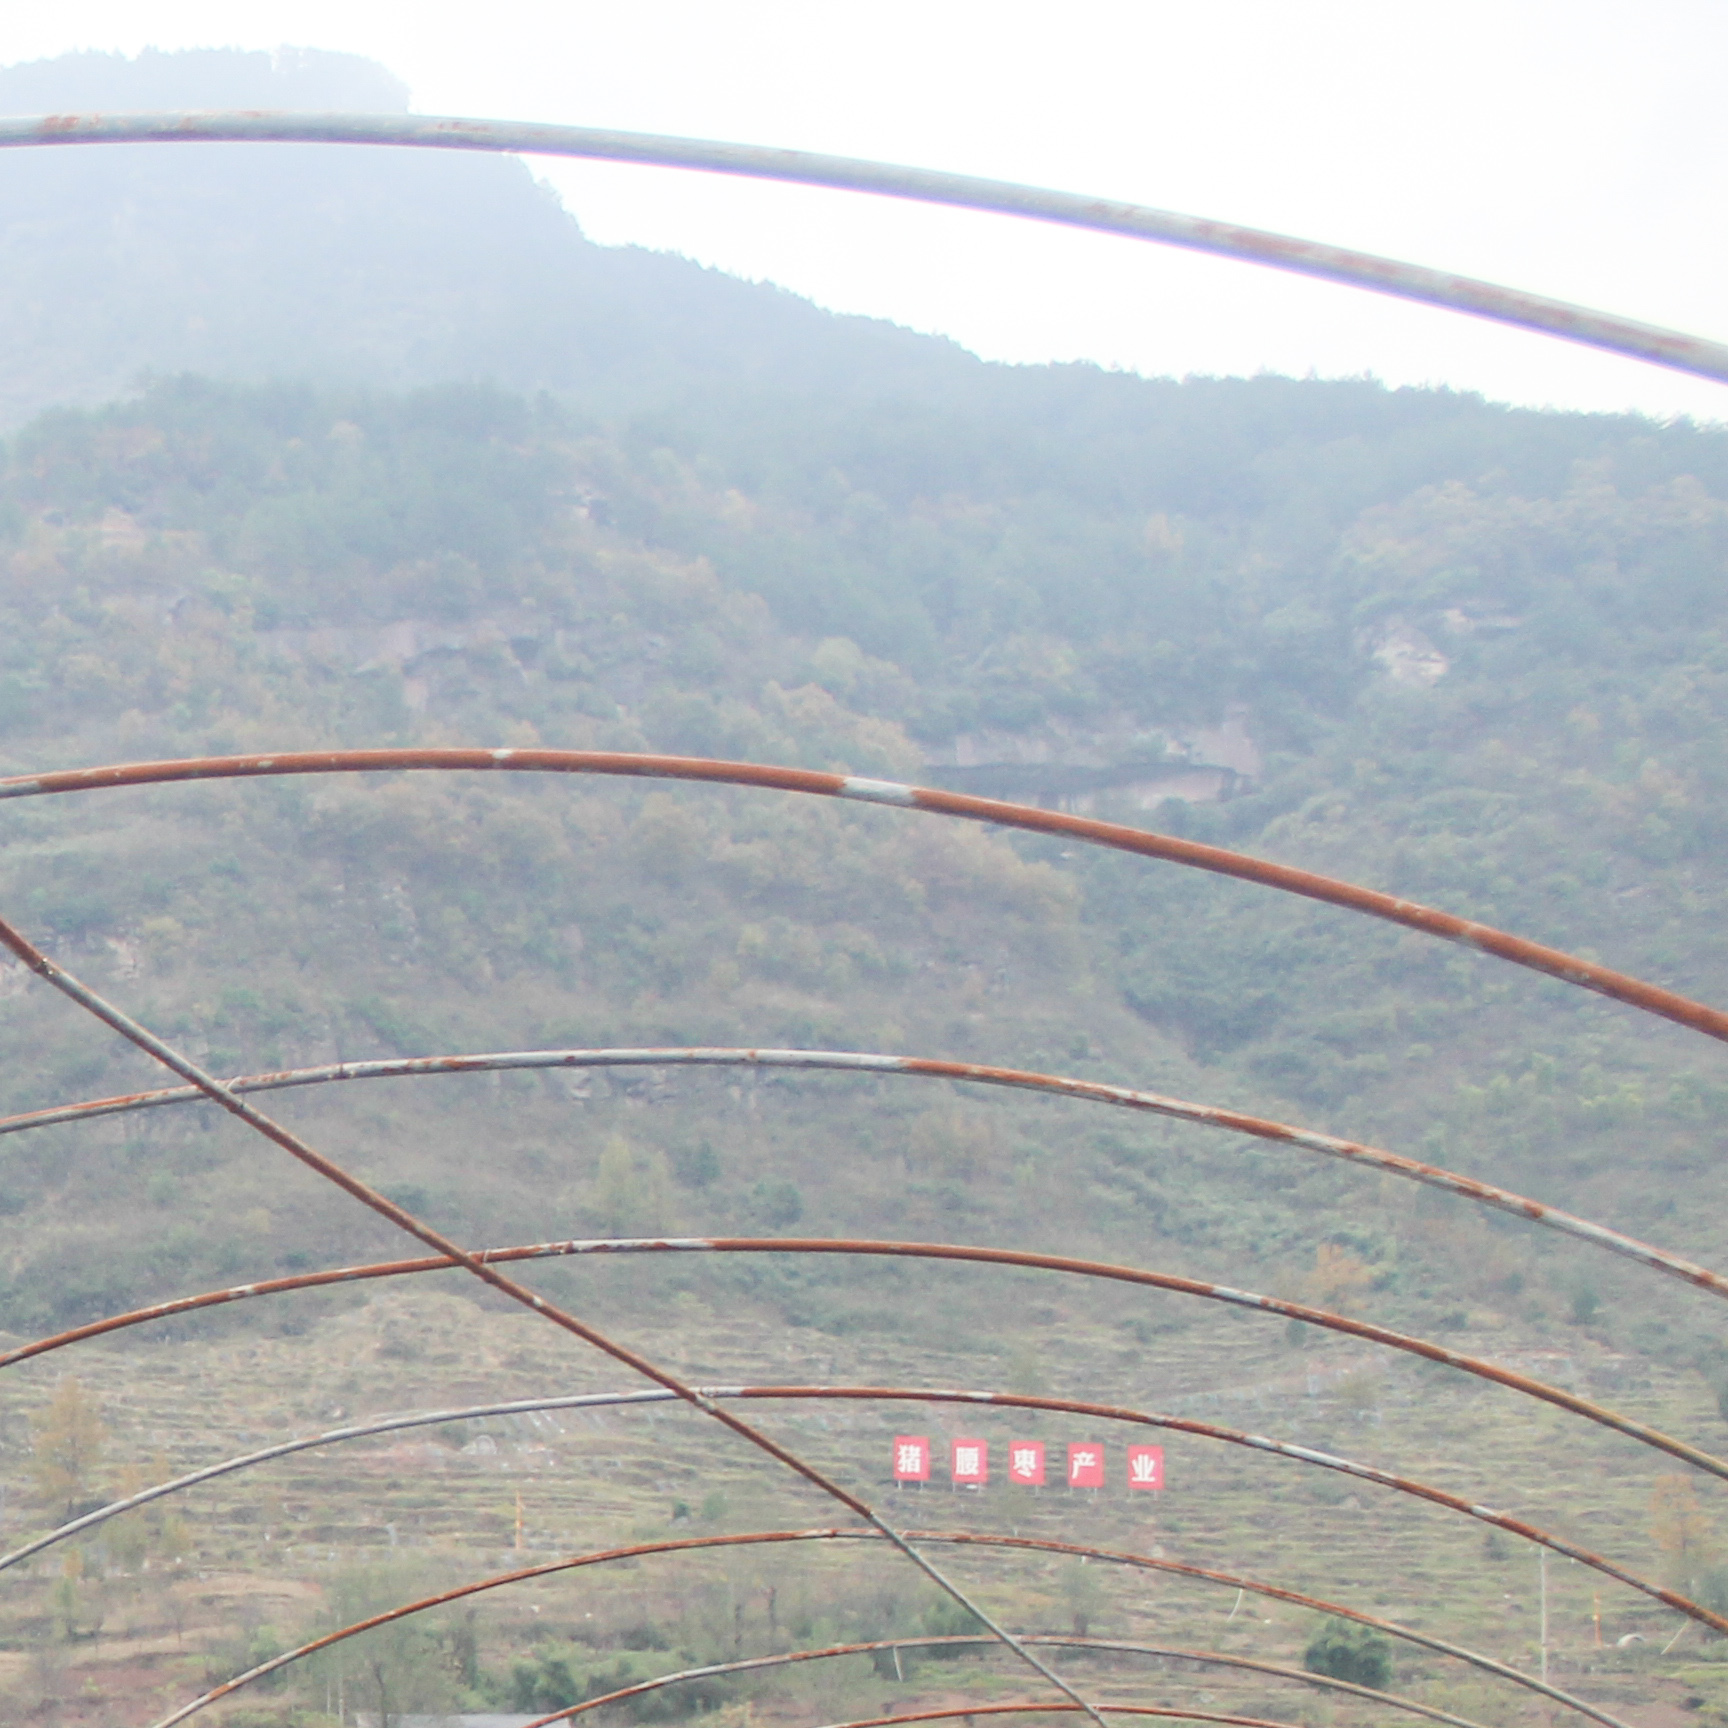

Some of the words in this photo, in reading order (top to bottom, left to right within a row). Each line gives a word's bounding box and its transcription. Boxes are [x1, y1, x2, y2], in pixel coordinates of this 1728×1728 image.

[897, 1444, 1156, 1483] 猪腰枣产业
